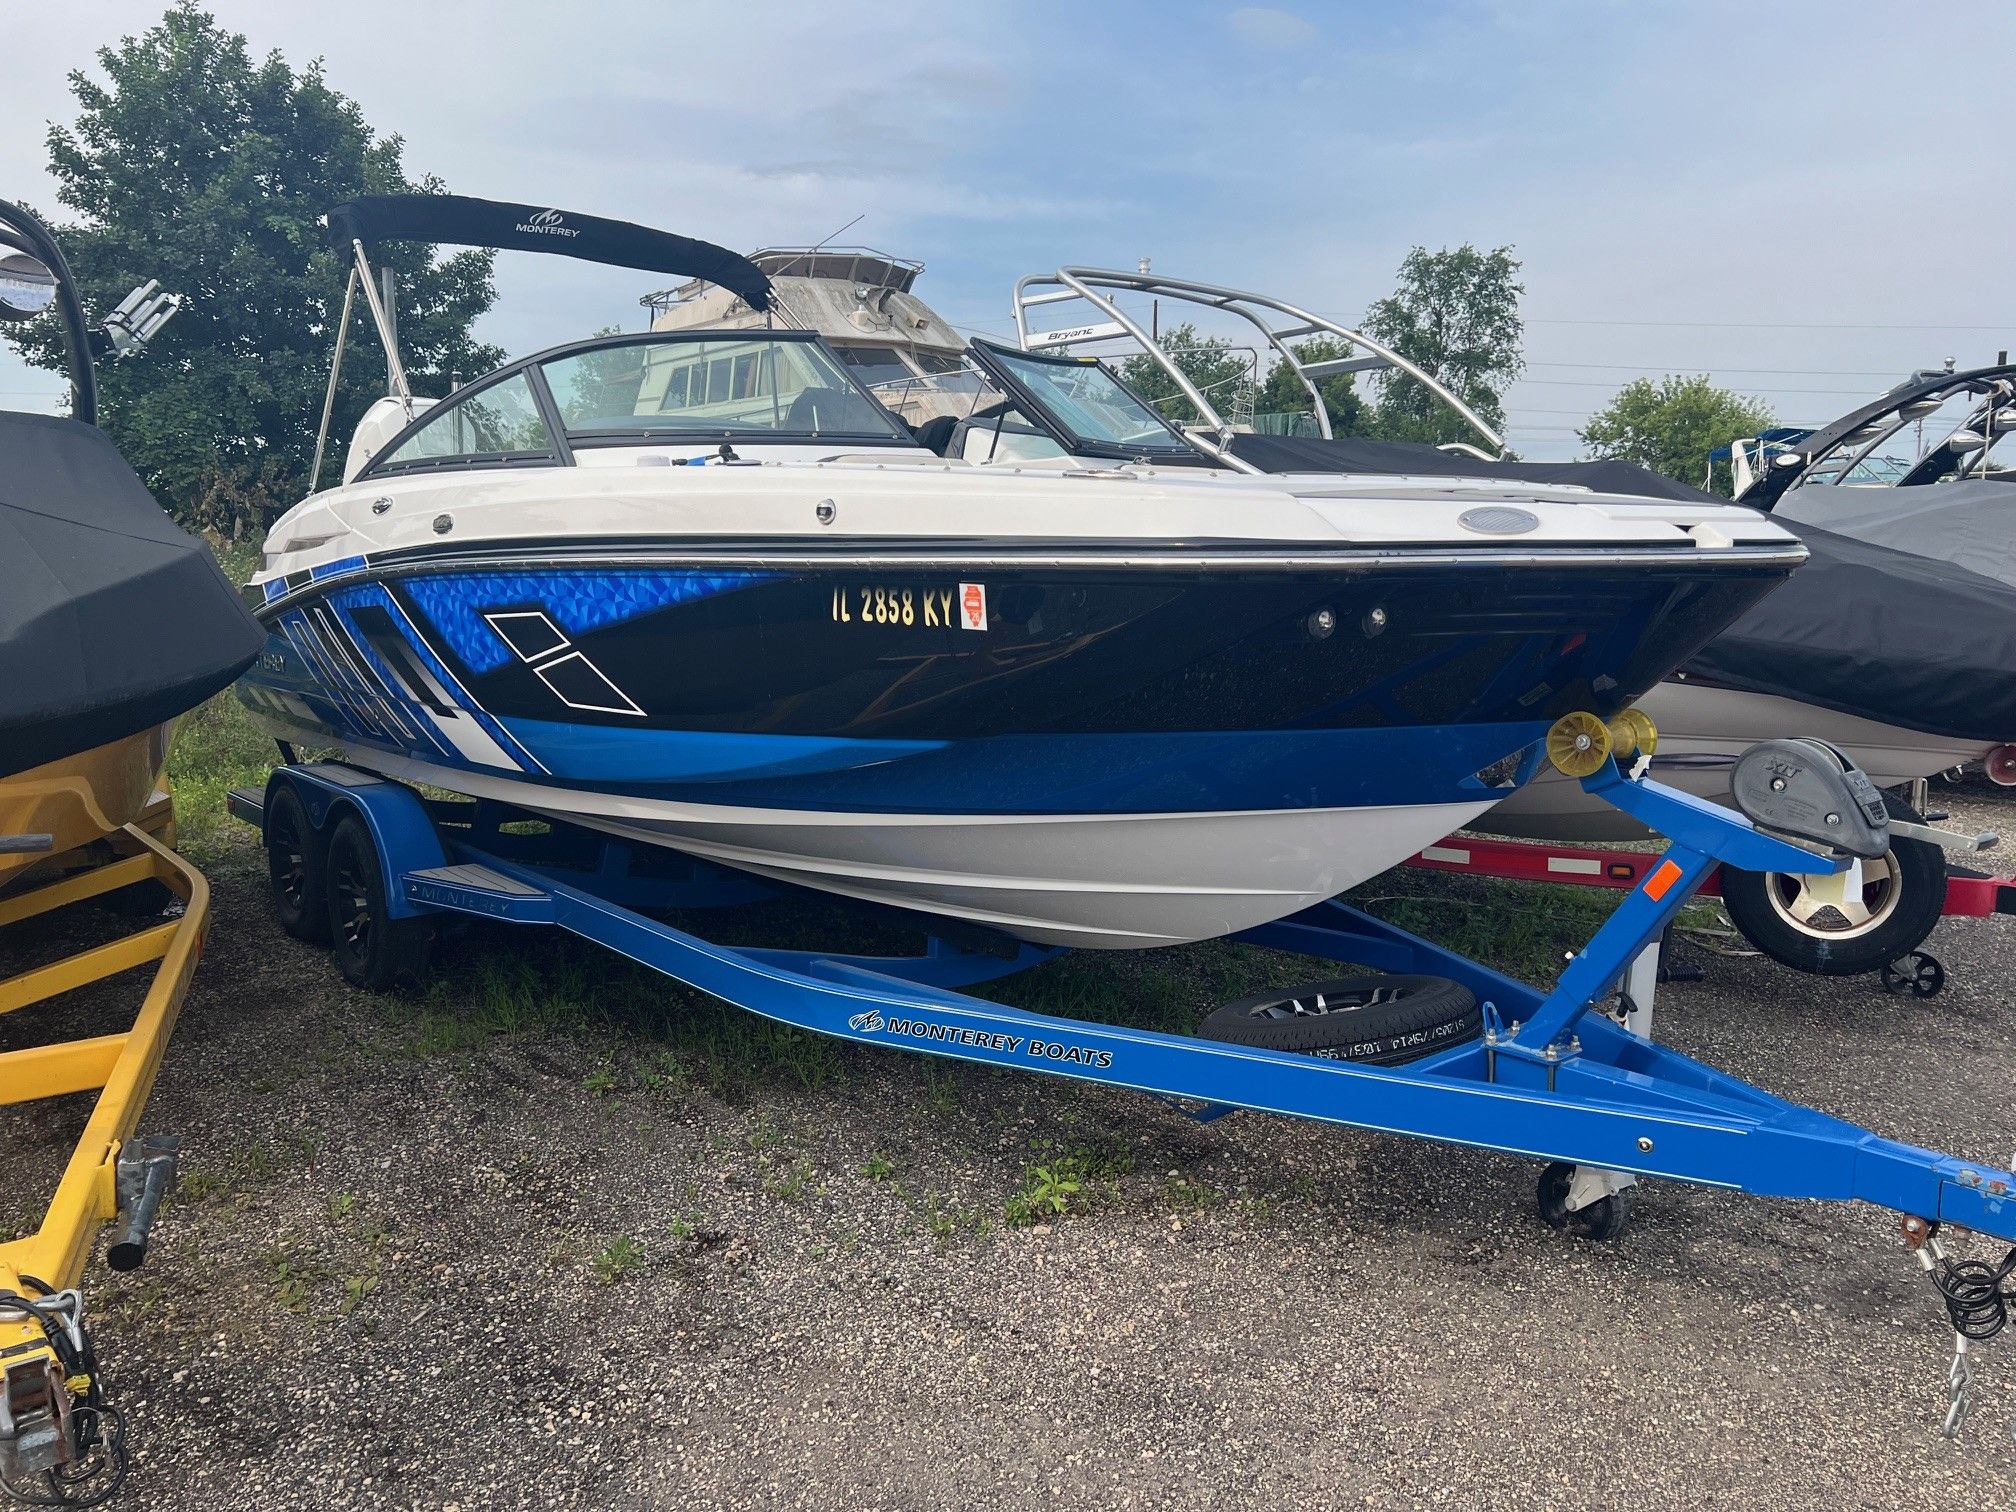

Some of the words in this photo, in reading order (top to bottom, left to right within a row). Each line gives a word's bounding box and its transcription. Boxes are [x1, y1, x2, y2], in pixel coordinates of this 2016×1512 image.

[516, 223, 580, 237] MONTEREY
[1048, 328, 1094, 340] Bryant
[832, 586, 850, 622] IL
[861, 586, 914, 626] 2858
[923, 588, 952, 628] KY
[421, 888, 510, 912] MONTEREY
[887, 1018, 1024, 1052] MONTEREY
[1028, 1039, 1113, 1068] BOATS
